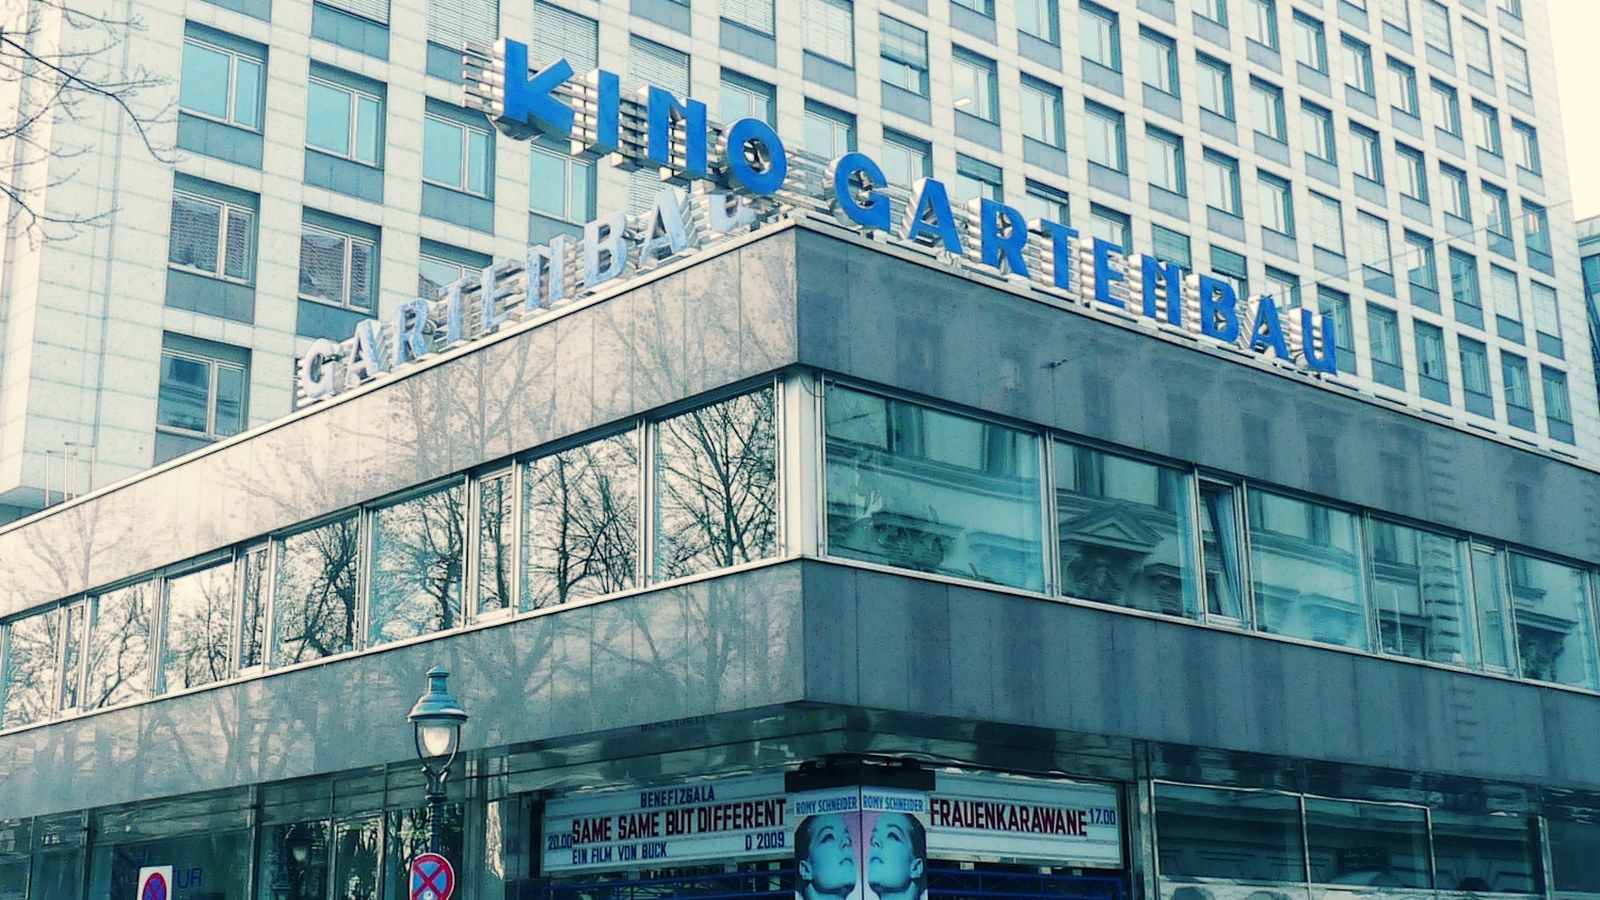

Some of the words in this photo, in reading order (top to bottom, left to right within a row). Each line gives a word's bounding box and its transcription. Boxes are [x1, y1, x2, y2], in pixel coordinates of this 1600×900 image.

[503, 37, 788, 195] KINO
[834, 151, 1337, 377] GARTENBAU
[299, 187, 758, 400] GARTENBAU
[640, 784, 715, 809] BENEFIZGALA
[796, 800, 816, 815] ROMY
[818, 795, 858, 812] SCHNEIDER
[863, 794, 883, 809] ROMY
[885, 796, 924, 812] SCHNEIDER
[572, 816, 612, 844] SAME
[618, 811, 660, 840] SAME
[665, 808, 694, 836] BUT
[697, 798, 787, 833] DIFFERENT
[930, 798, 1087, 836] FRAUENKARAWANE
[1088, 808, 1116, 825] 17.00
[547, 834, 573, 850] 20.00
[572, 848, 588, 865] EIN
[591, 846, 612, 863] FILM
[617, 844, 637, 861] VON
[641, 841, 667, 860] BUCK
[744, 834, 753, 851] D
[756, 831, 785, 850] 2009
